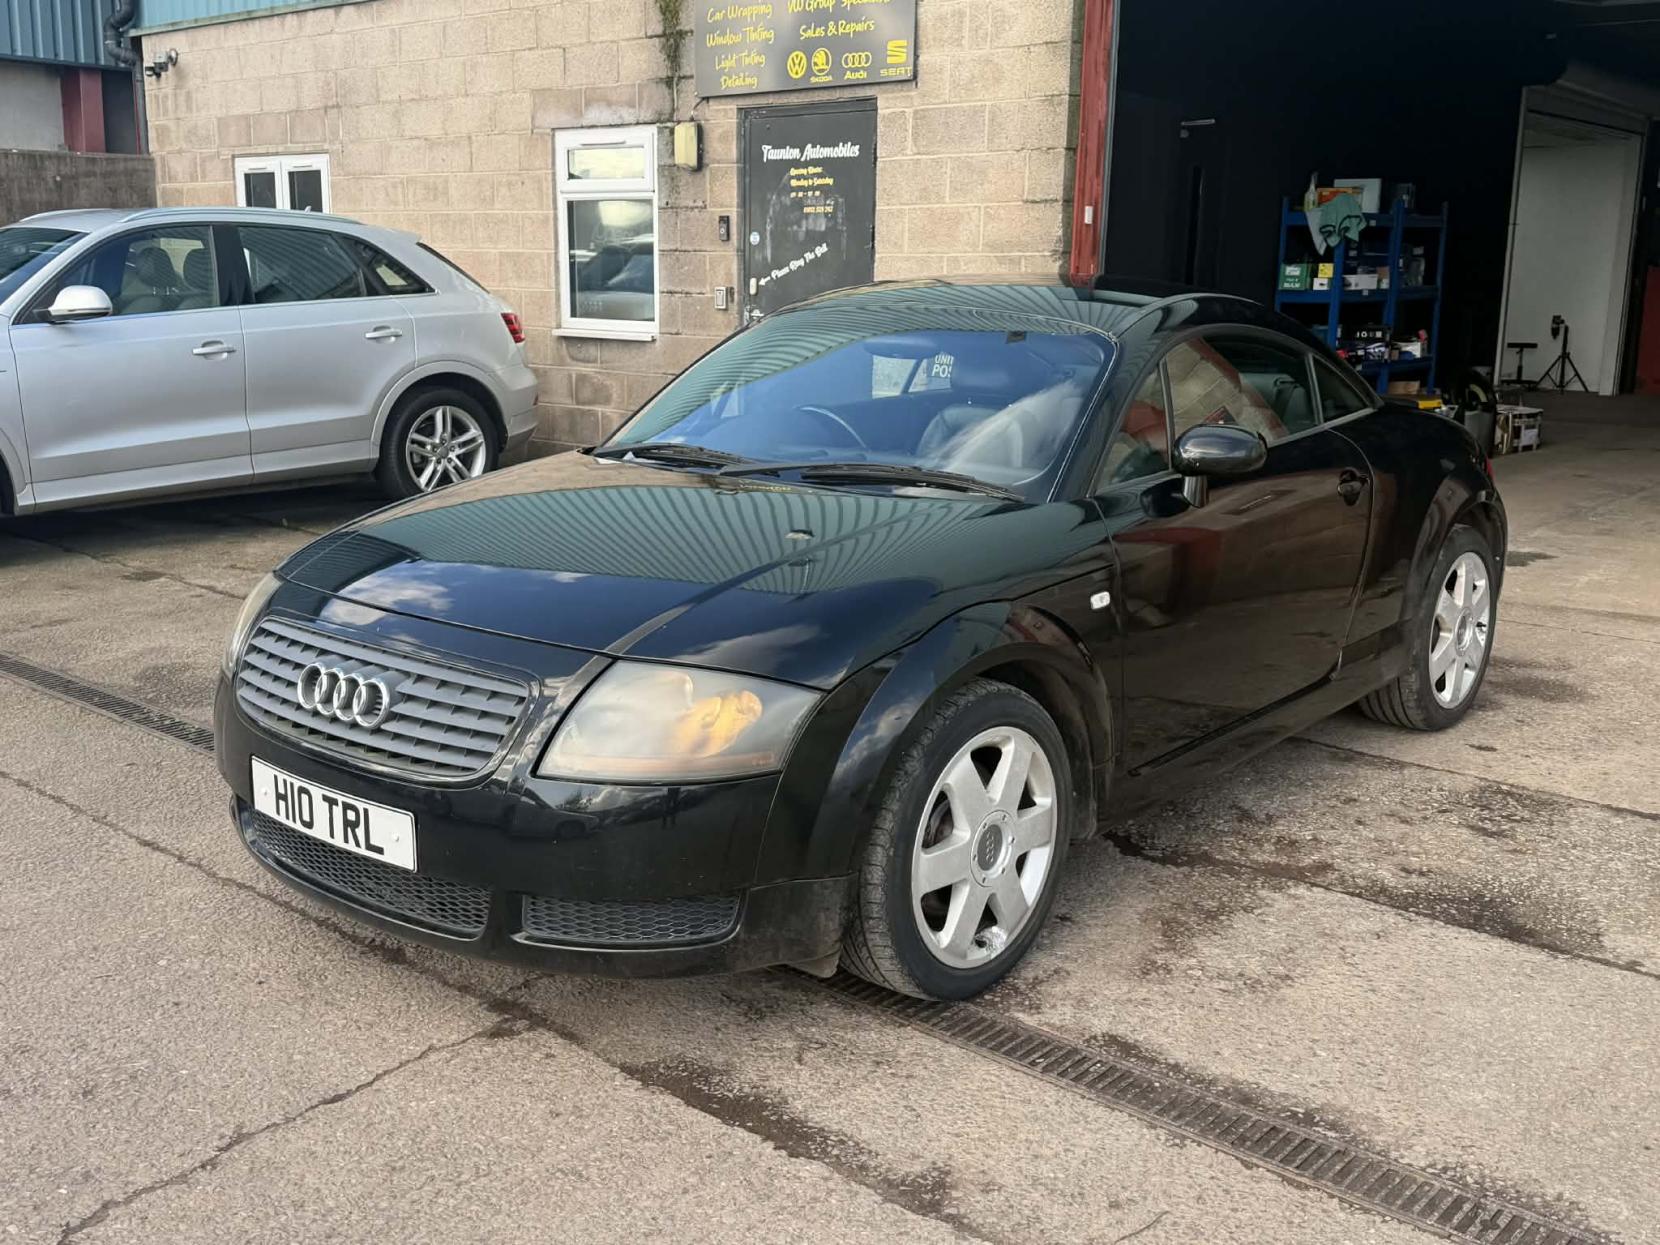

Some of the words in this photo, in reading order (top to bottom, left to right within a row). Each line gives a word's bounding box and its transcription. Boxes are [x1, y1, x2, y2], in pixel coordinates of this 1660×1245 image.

[707, 8, 725, 22] Car
[727, 4, 772, 21] Wrapping
[805, 0, 836, 13] Group
[706, 28, 742, 47] Window
[742, 22, 774, 44] Tinting
[800, 22, 825, 40] Sales
[827, 21, 837, 36] &
[838, 16, 875, 38] Repairs
[715, 53, 737, 71] Light
[738, 49, 765, 67] Tinting
[721, 73, 757, 89] Detailing
[844, 70, 867, 80] Audi
[880, 67, 912, 77] SEAT
[761, 145, 801, 163] Taunton
[801, 141, 860, 162] Automobiles
[321, 793, 385, 856] TRL
